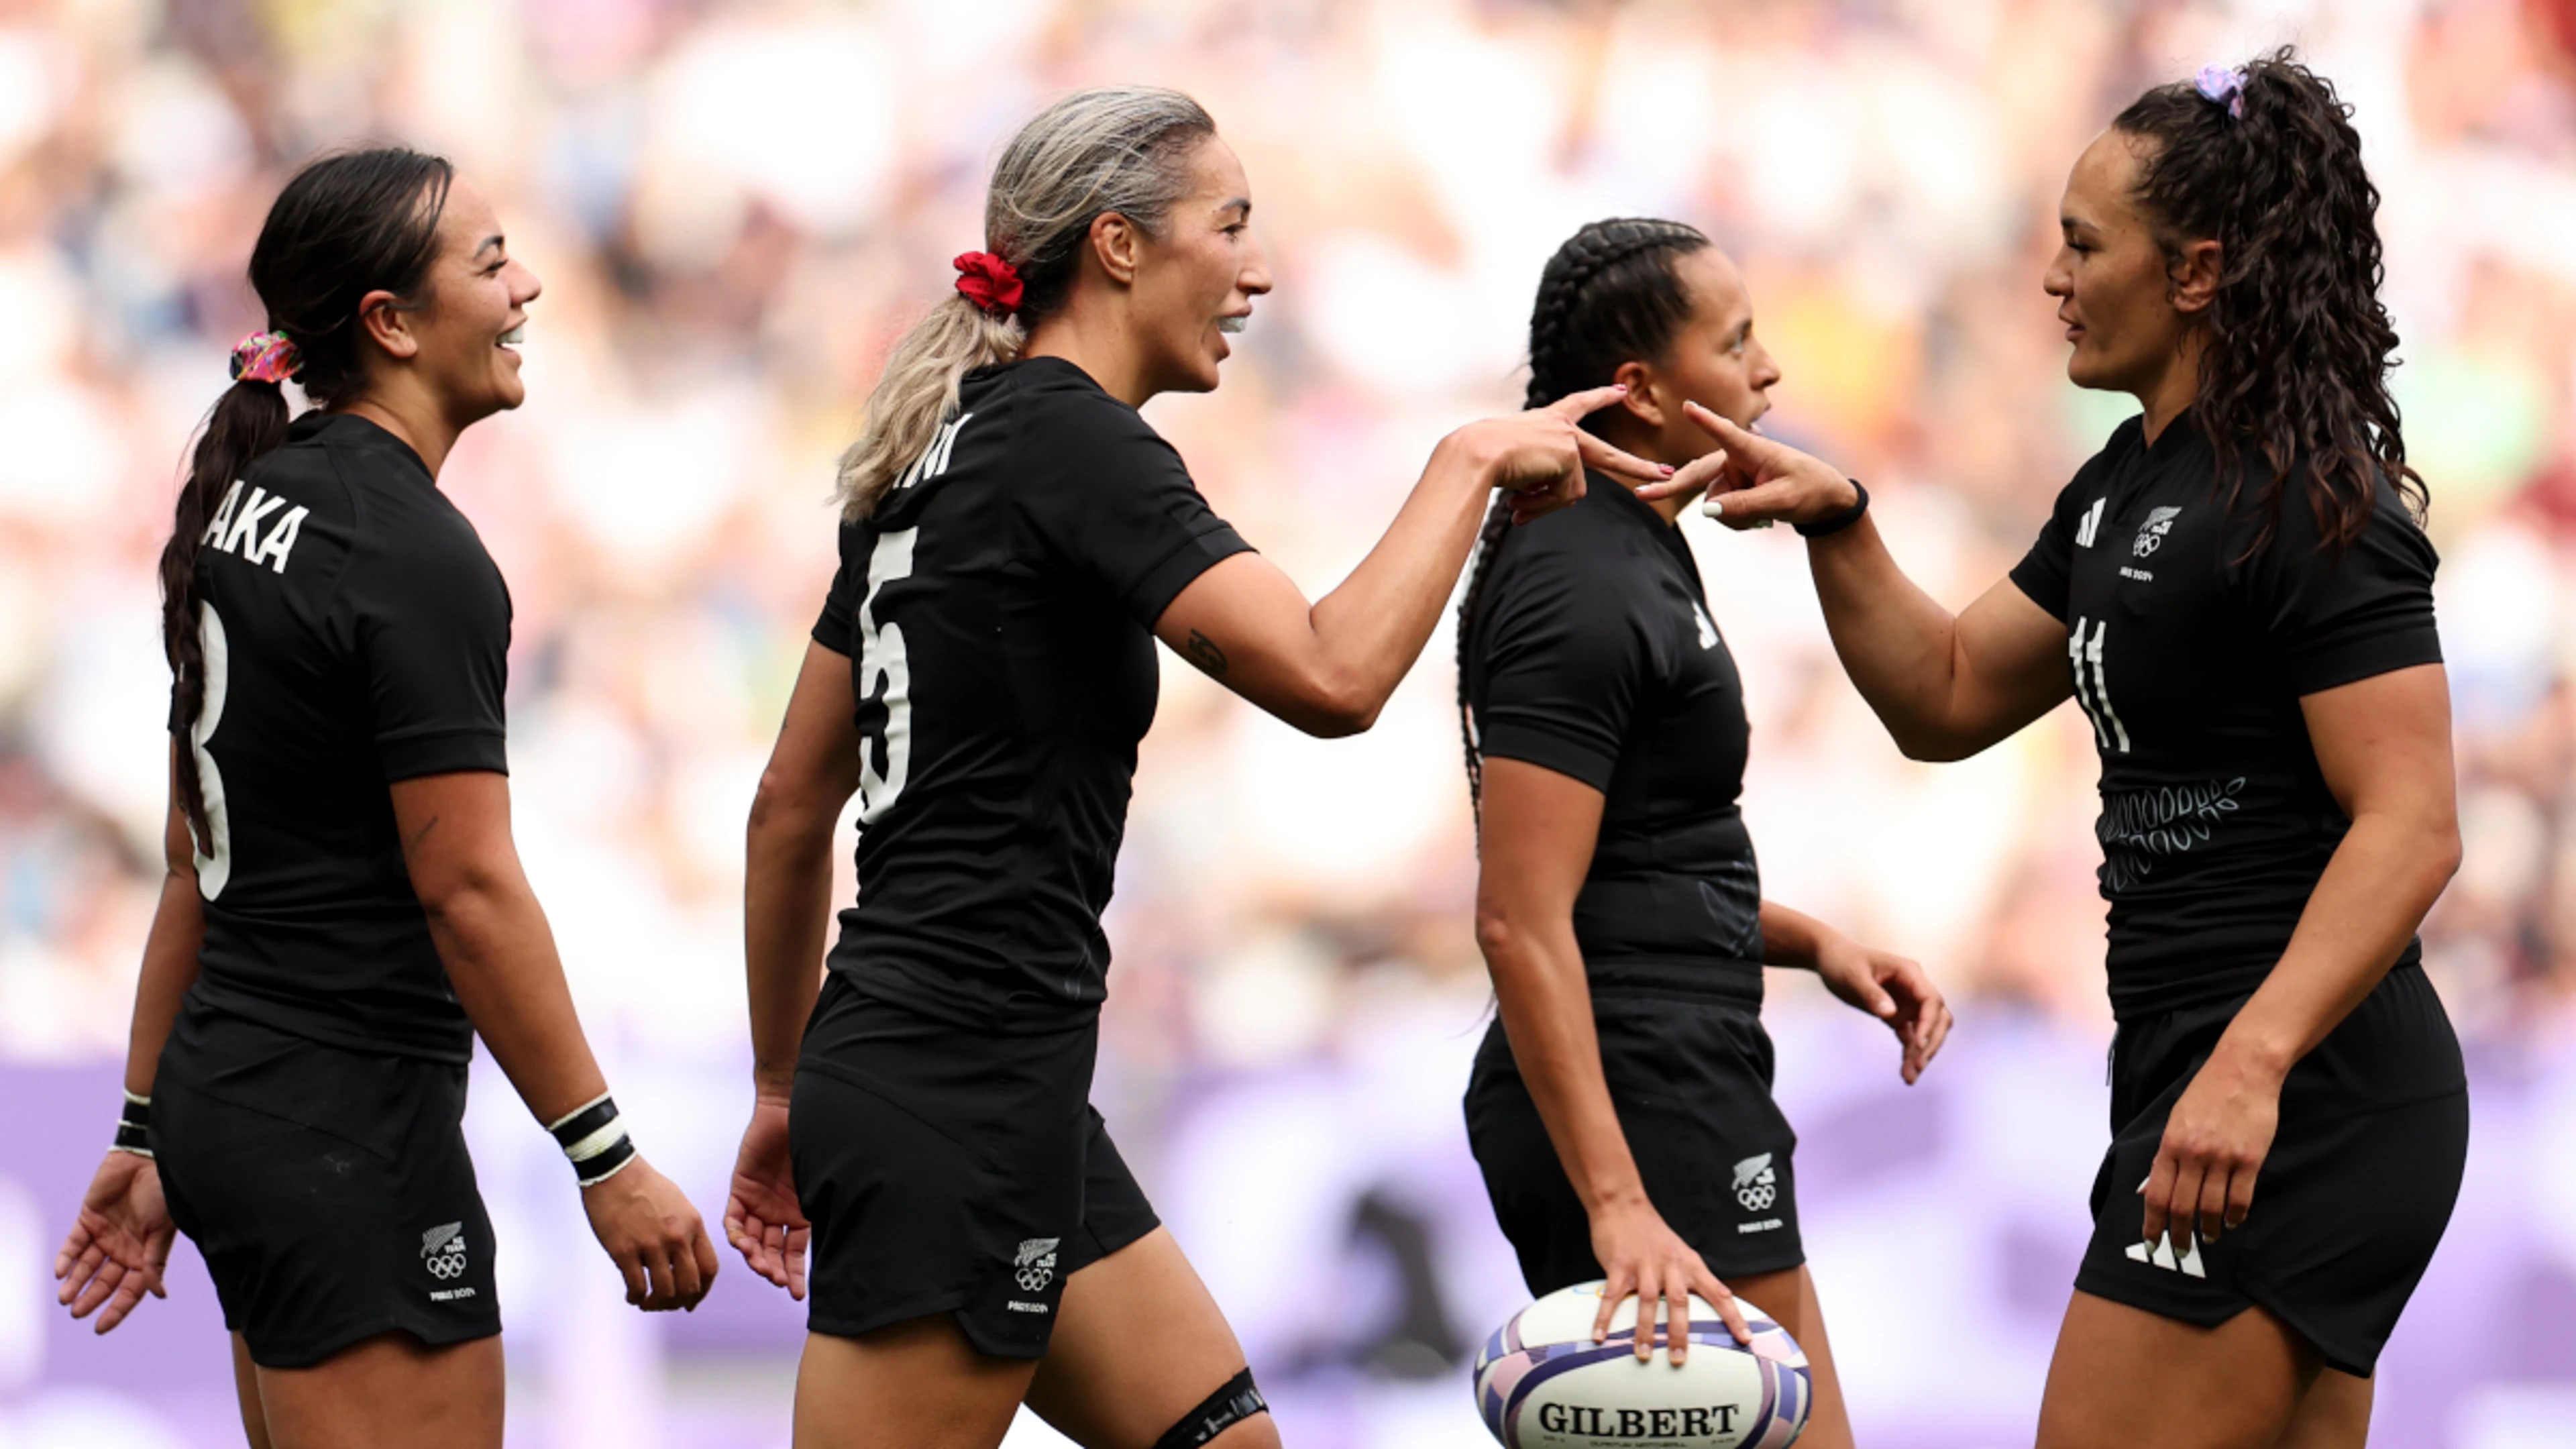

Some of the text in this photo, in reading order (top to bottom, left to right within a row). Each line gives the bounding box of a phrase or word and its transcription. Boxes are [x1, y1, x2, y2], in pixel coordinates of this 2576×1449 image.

[859, 526, 918, 824] 5
[2069, 616, 2130, 753] 11
[1538, 1401, 1739, 1438] GILBERT
